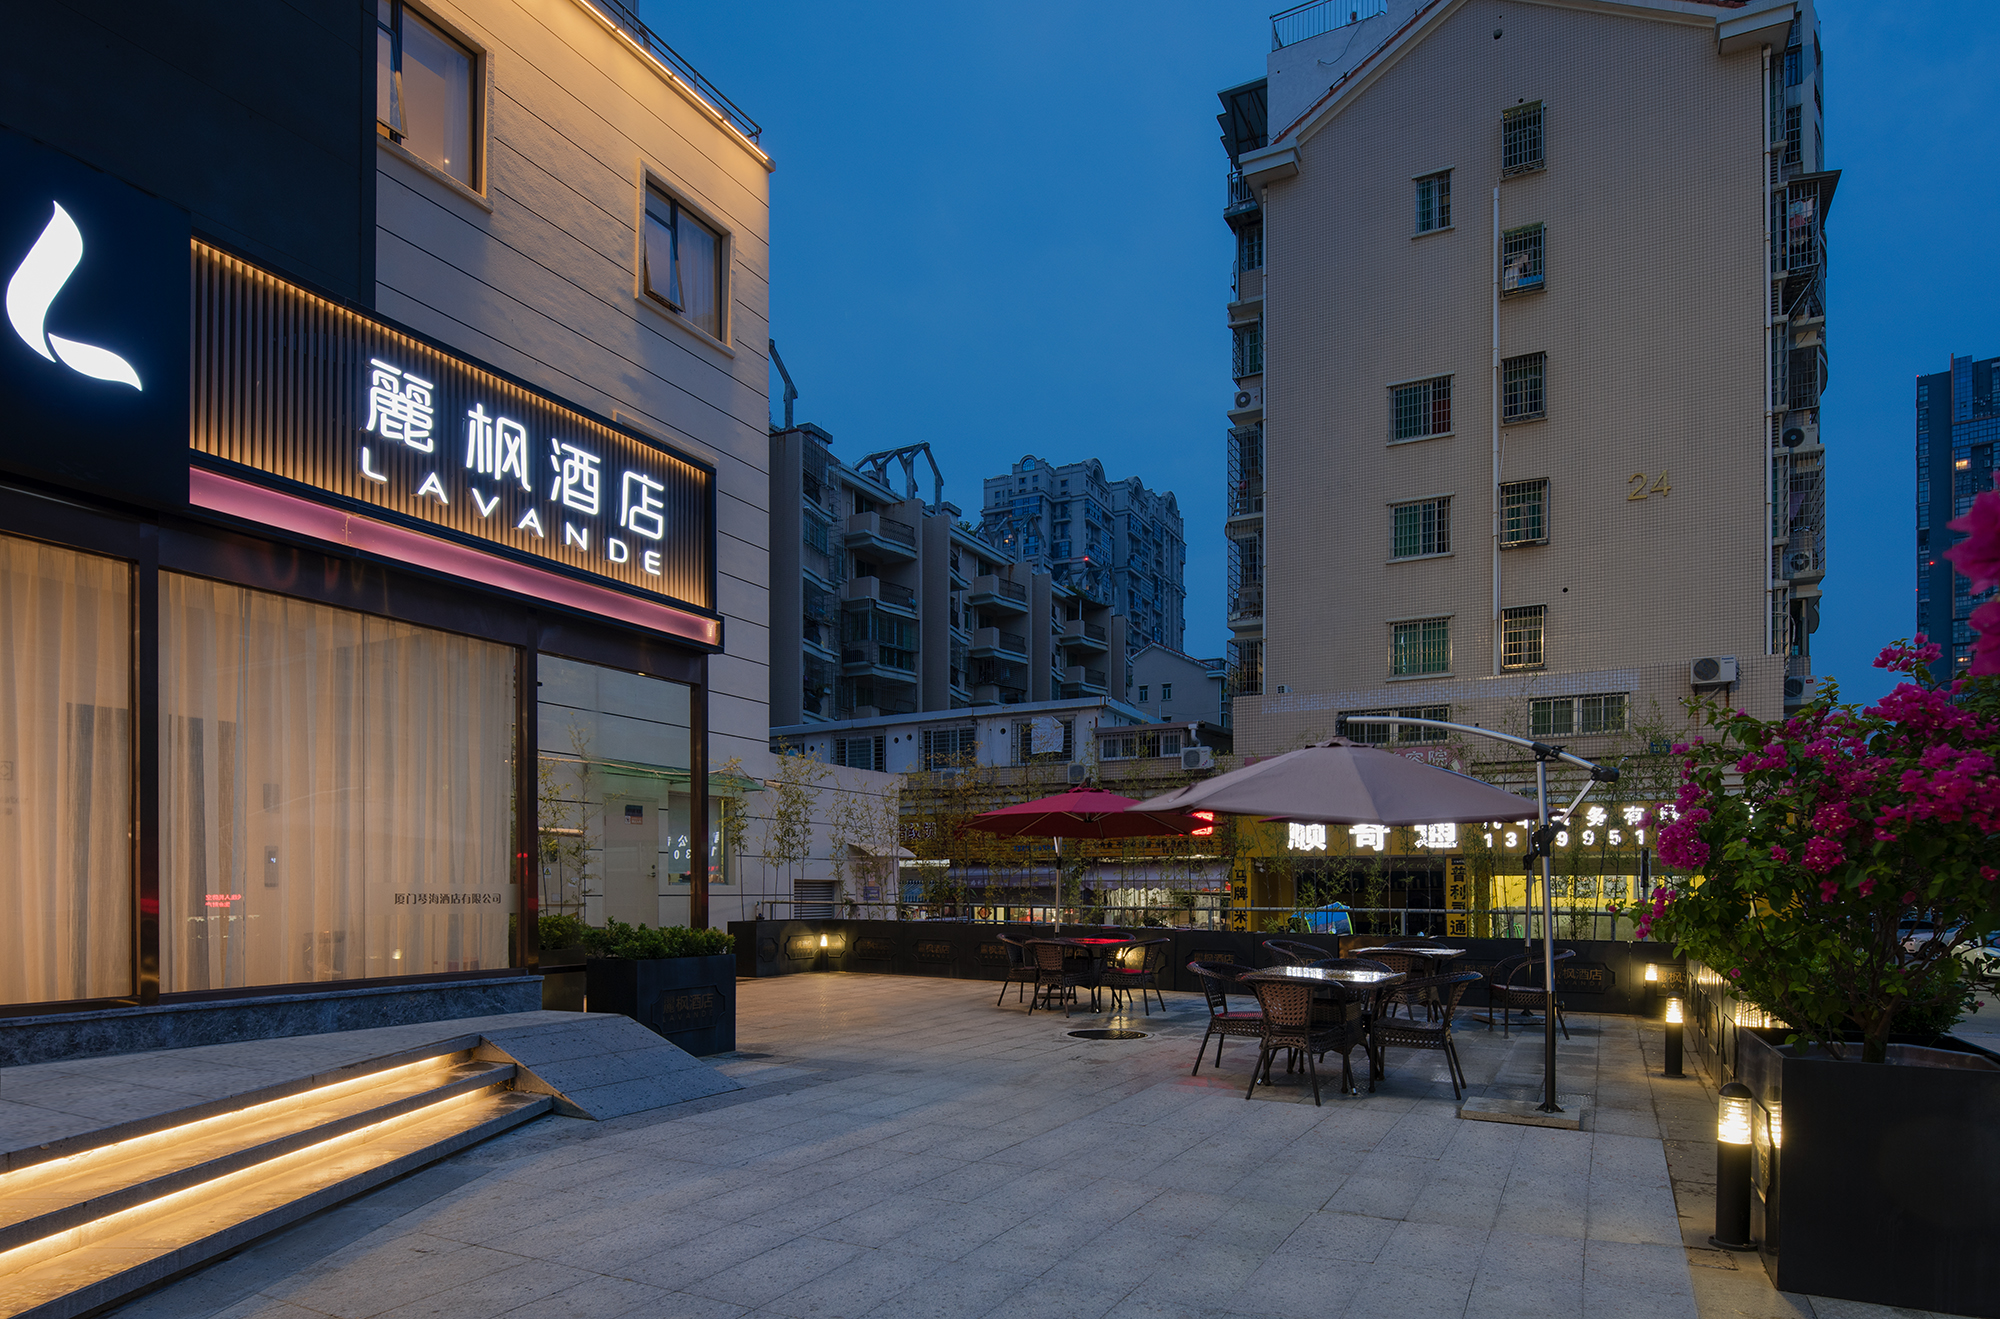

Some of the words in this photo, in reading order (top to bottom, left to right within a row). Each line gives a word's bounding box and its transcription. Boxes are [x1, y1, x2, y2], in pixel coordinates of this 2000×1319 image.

[366, 358, 665, 540] 麗枫酒店
[1628, 469, 1672, 501] 24
[362, 446, 662, 576] LAVANDE
[1393, 749, 1448, 767] 容院
[1484, 828, 1644, 848] 139951
[394, 893, 502, 905] 厦门琴海酒店有限公司
[1450, 866, 1466, 936] 普利司通
[662, 1009, 714, 1023] LAVANDE
